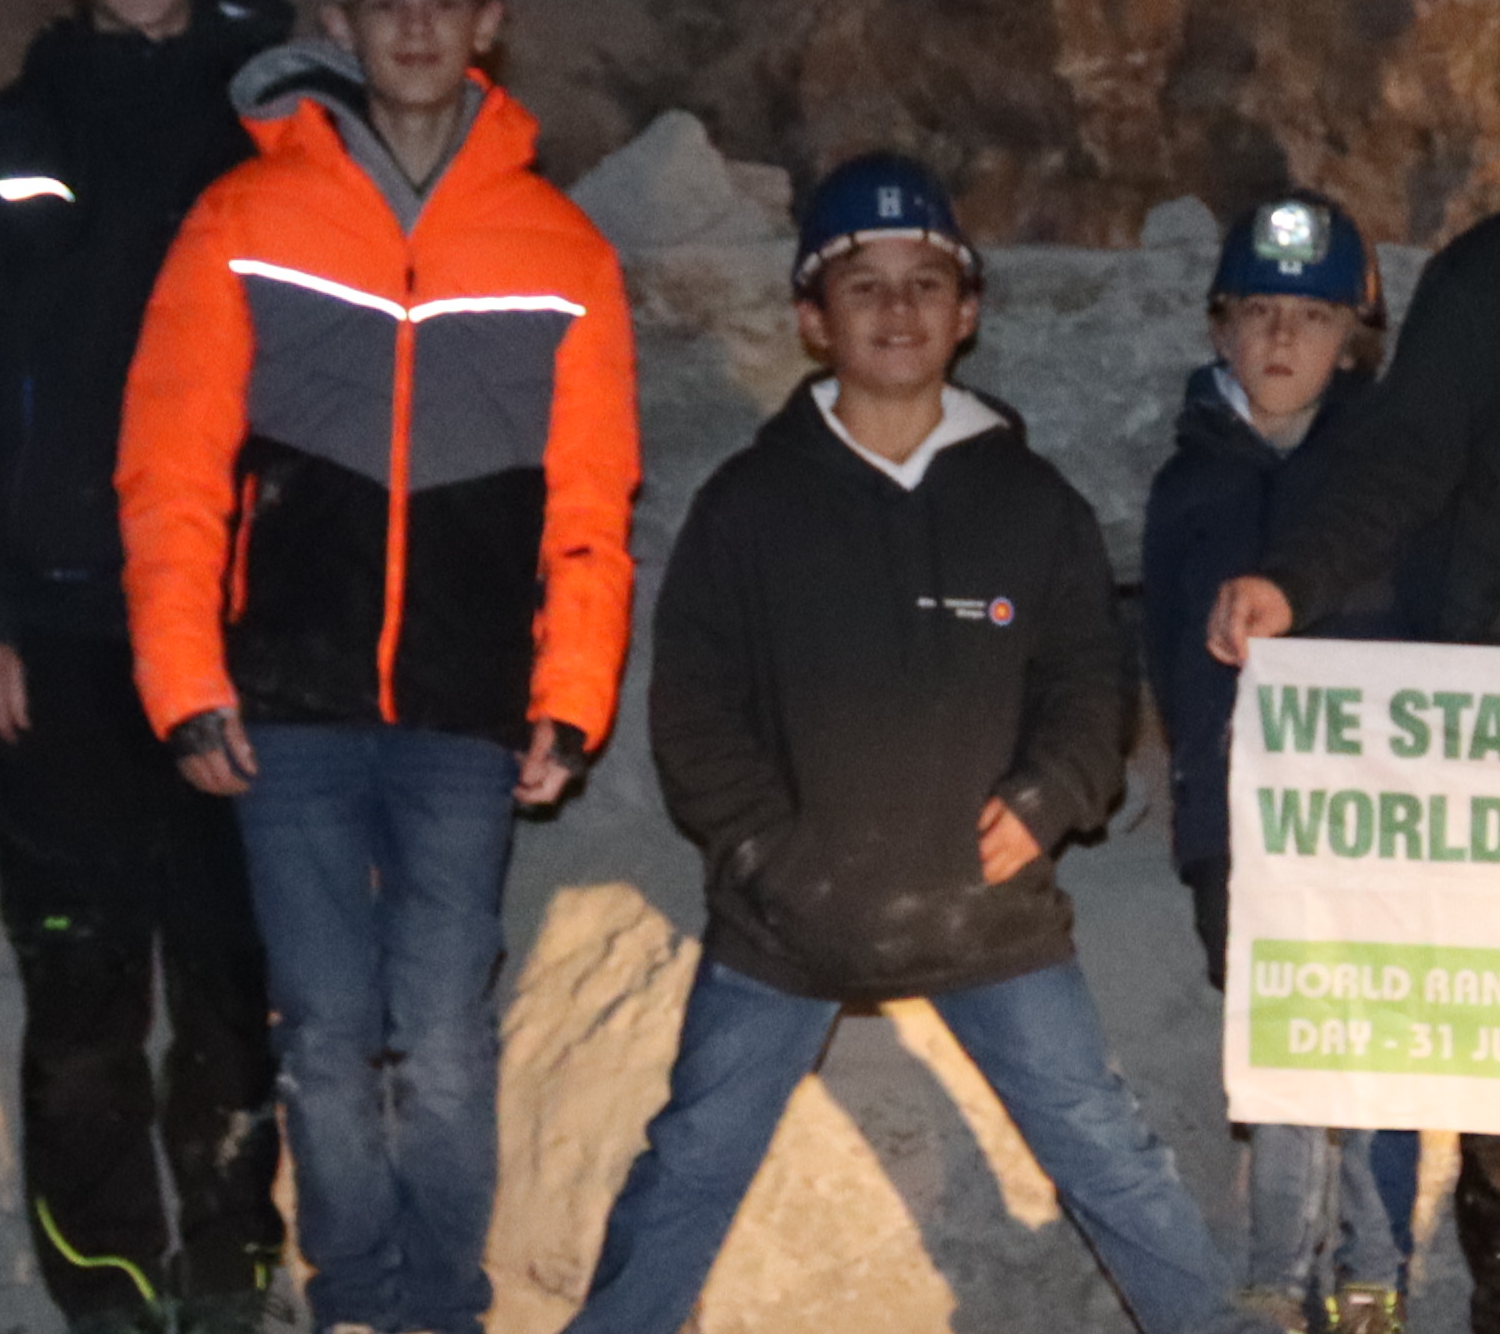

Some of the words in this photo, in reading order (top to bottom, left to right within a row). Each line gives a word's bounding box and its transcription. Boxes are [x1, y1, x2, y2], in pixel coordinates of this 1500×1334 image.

[1257, 684, 1363, 756] WE
[1256, 960, 1412, 1002] WORLD
[1288, 1018, 1373, 1057] DAY
[1409, 1022, 1454, 1060] 31
